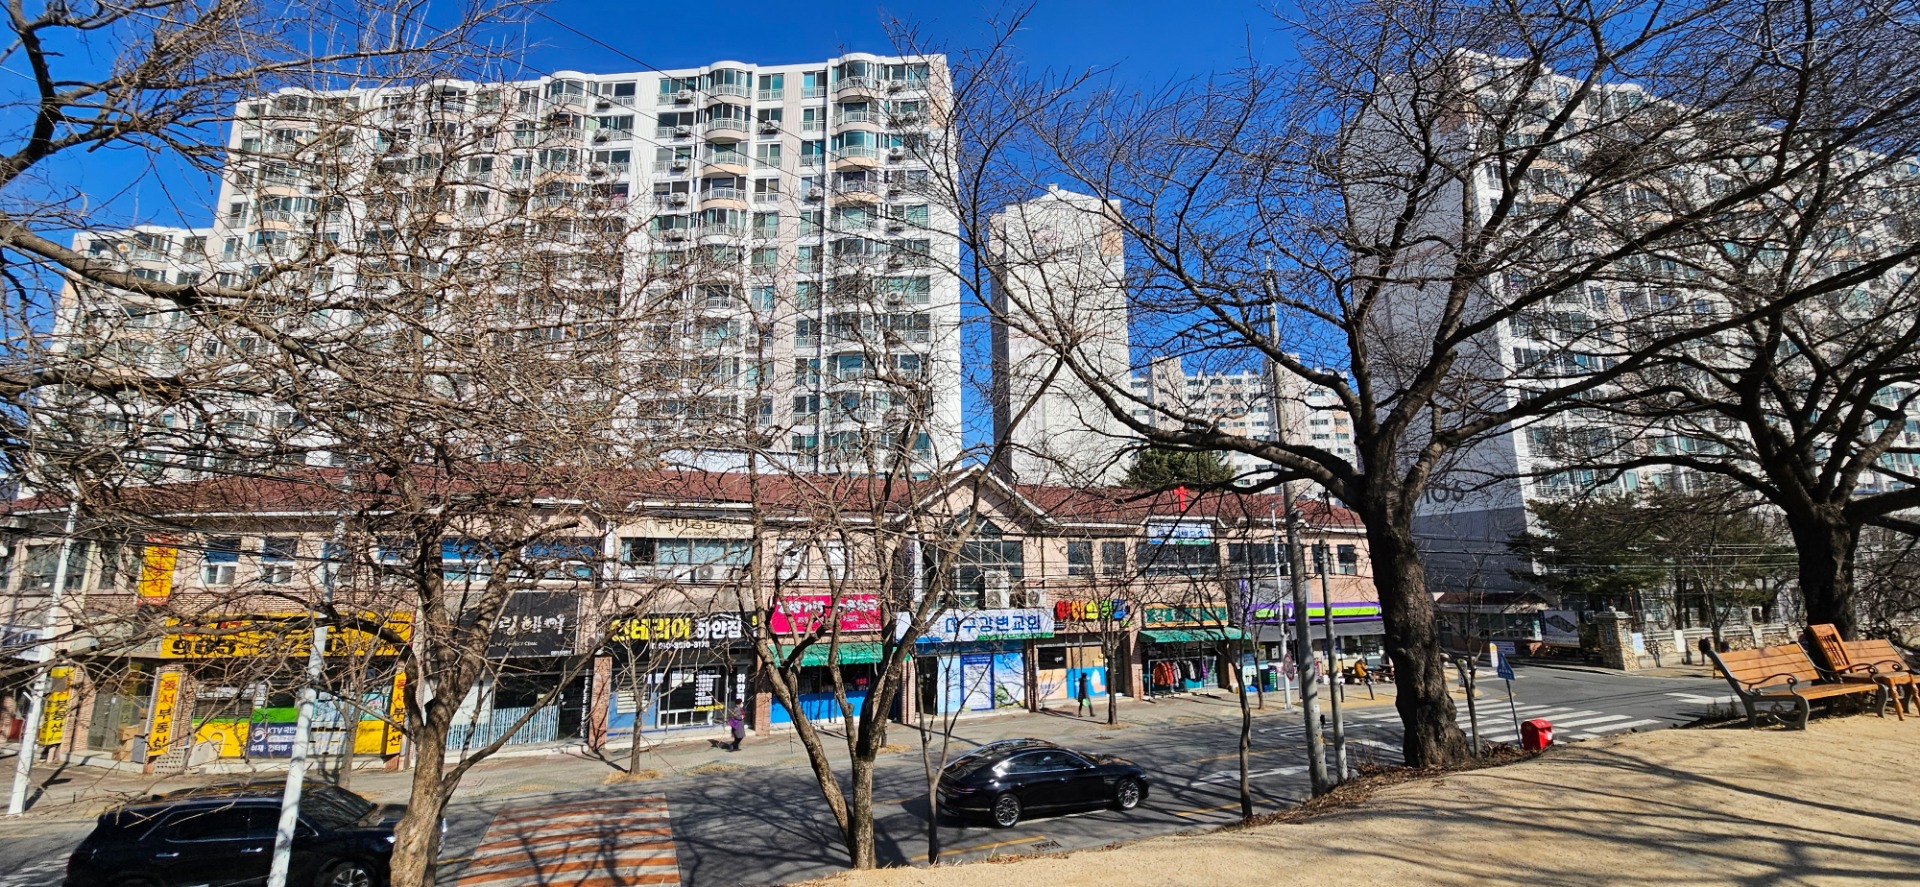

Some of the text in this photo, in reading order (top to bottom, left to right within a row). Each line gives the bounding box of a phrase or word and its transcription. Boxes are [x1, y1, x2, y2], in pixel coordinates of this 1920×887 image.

[609, 617, 691, 641] 인테리어
[695, 616, 742, 639] 하얀집
[945, 615, 1041, 633] 대구강변교회
[151, 679, 175, 750] 동서부동산
[267, 726, 283, 734] KTV
